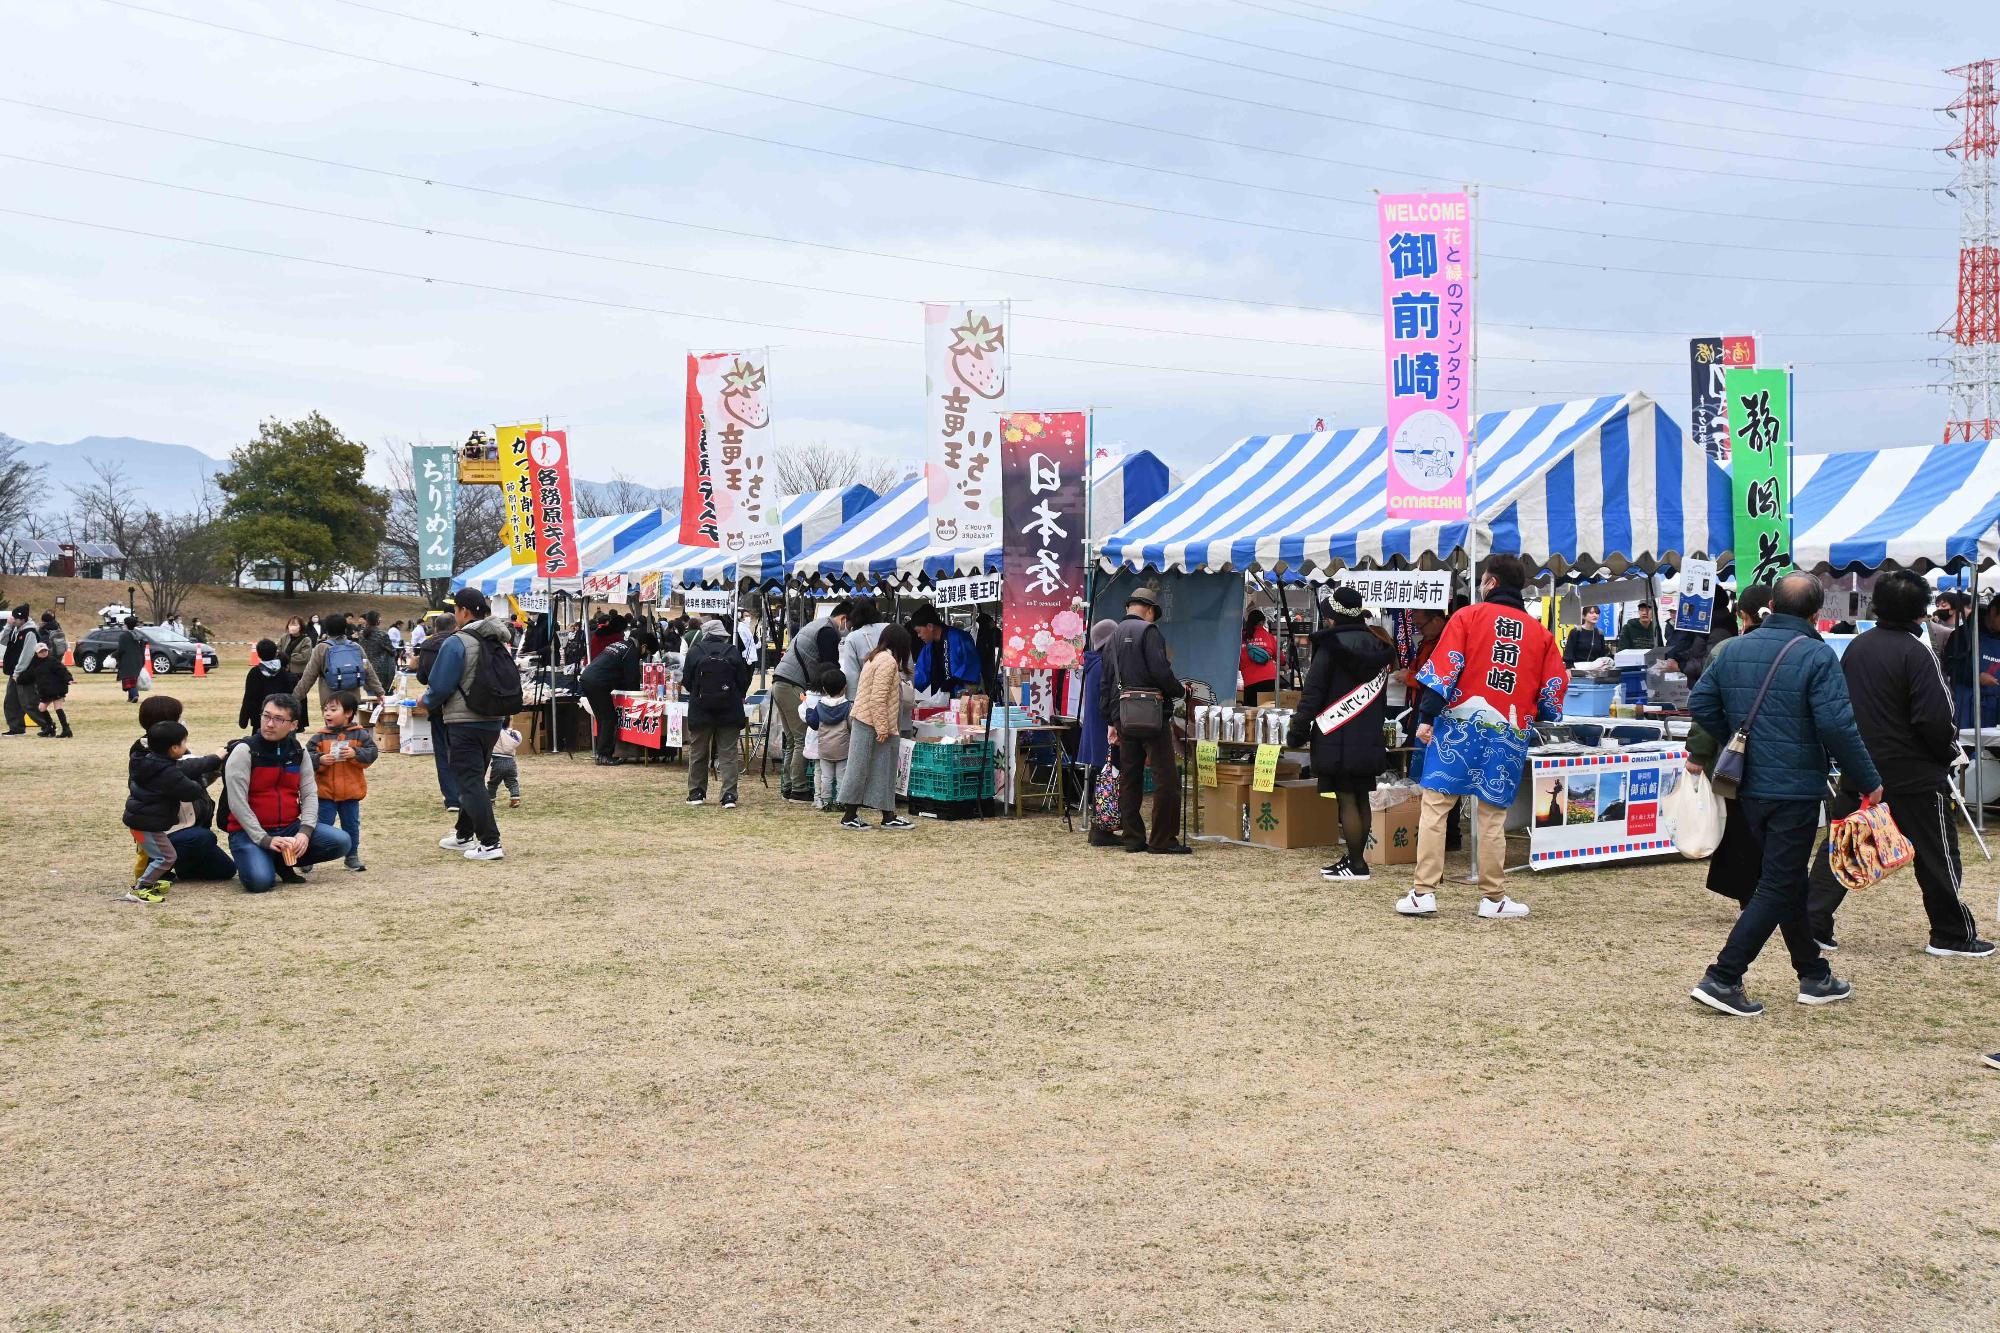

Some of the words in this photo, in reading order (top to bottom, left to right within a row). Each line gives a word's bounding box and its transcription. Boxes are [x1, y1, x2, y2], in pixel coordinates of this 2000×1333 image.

[1385, 203, 1466, 221] WELCOME
[1389, 232, 1440, 400] 御前崎
[1443, 228, 1463, 410] 花と緑のマリンタウン
[422, 458, 449, 557] ちりめん
[538, 469, 566, 573] 各務原キムチ
[1738, 390, 1790, 586] 静岡茶
[938, 584, 967, 603] 滋賀県
[970, 580, 999, 601] 竜王町
[1487, 616, 1523, 694] 御前崎
[1256, 802, 1279, 831] 茶
[1631, 782, 1659, 795] 御前崎
